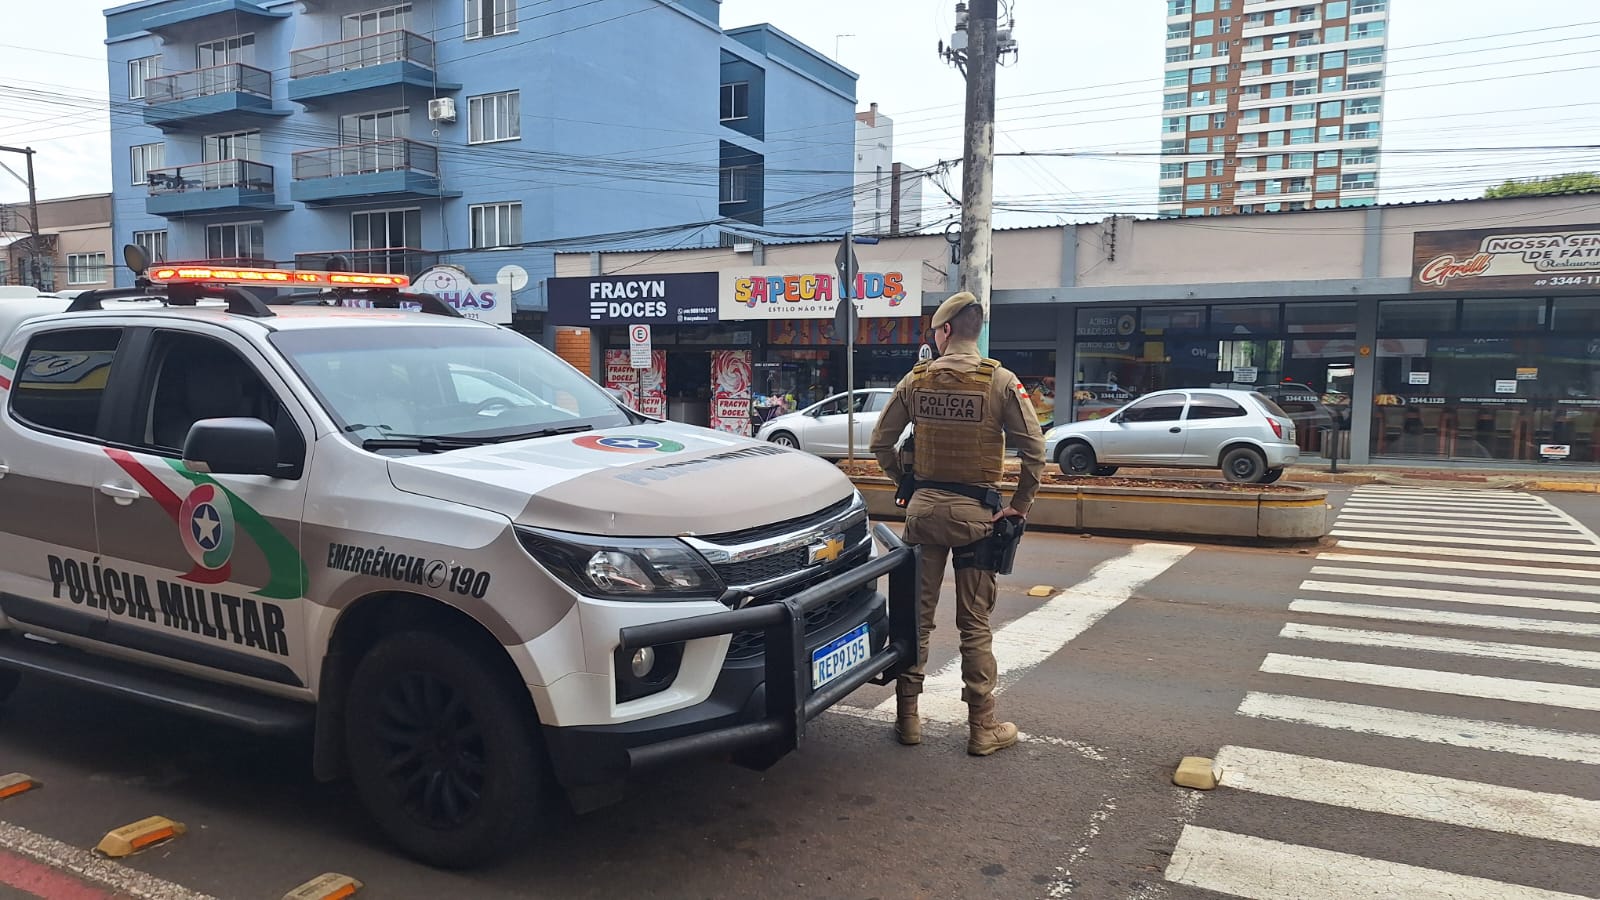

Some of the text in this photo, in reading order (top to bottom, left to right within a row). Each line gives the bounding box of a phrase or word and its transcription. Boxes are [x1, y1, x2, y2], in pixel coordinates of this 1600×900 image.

[1492, 238, 1560, 250] NOSSA
[1529, 250, 1553, 259] DE
[1421, 254, 1491, 284] Grill
[590, 280, 665, 299] FRACYN
[735, 273, 833, 303] SAPECA
[609, 301, 667, 318] DOCES
[798, 304, 815, 312] NÃO
[637, 329, 643, 339] E
[720, 400, 748, 408] FRACYN
[920, 394, 974, 409] POLÍCIA
[722, 409, 745, 417] DOCES
[920, 406, 974, 418] MILITAR
[327, 542, 491, 599] EMERGÊNCIA 190
[48, 555, 289, 657] POLÍCIA MILITAR
